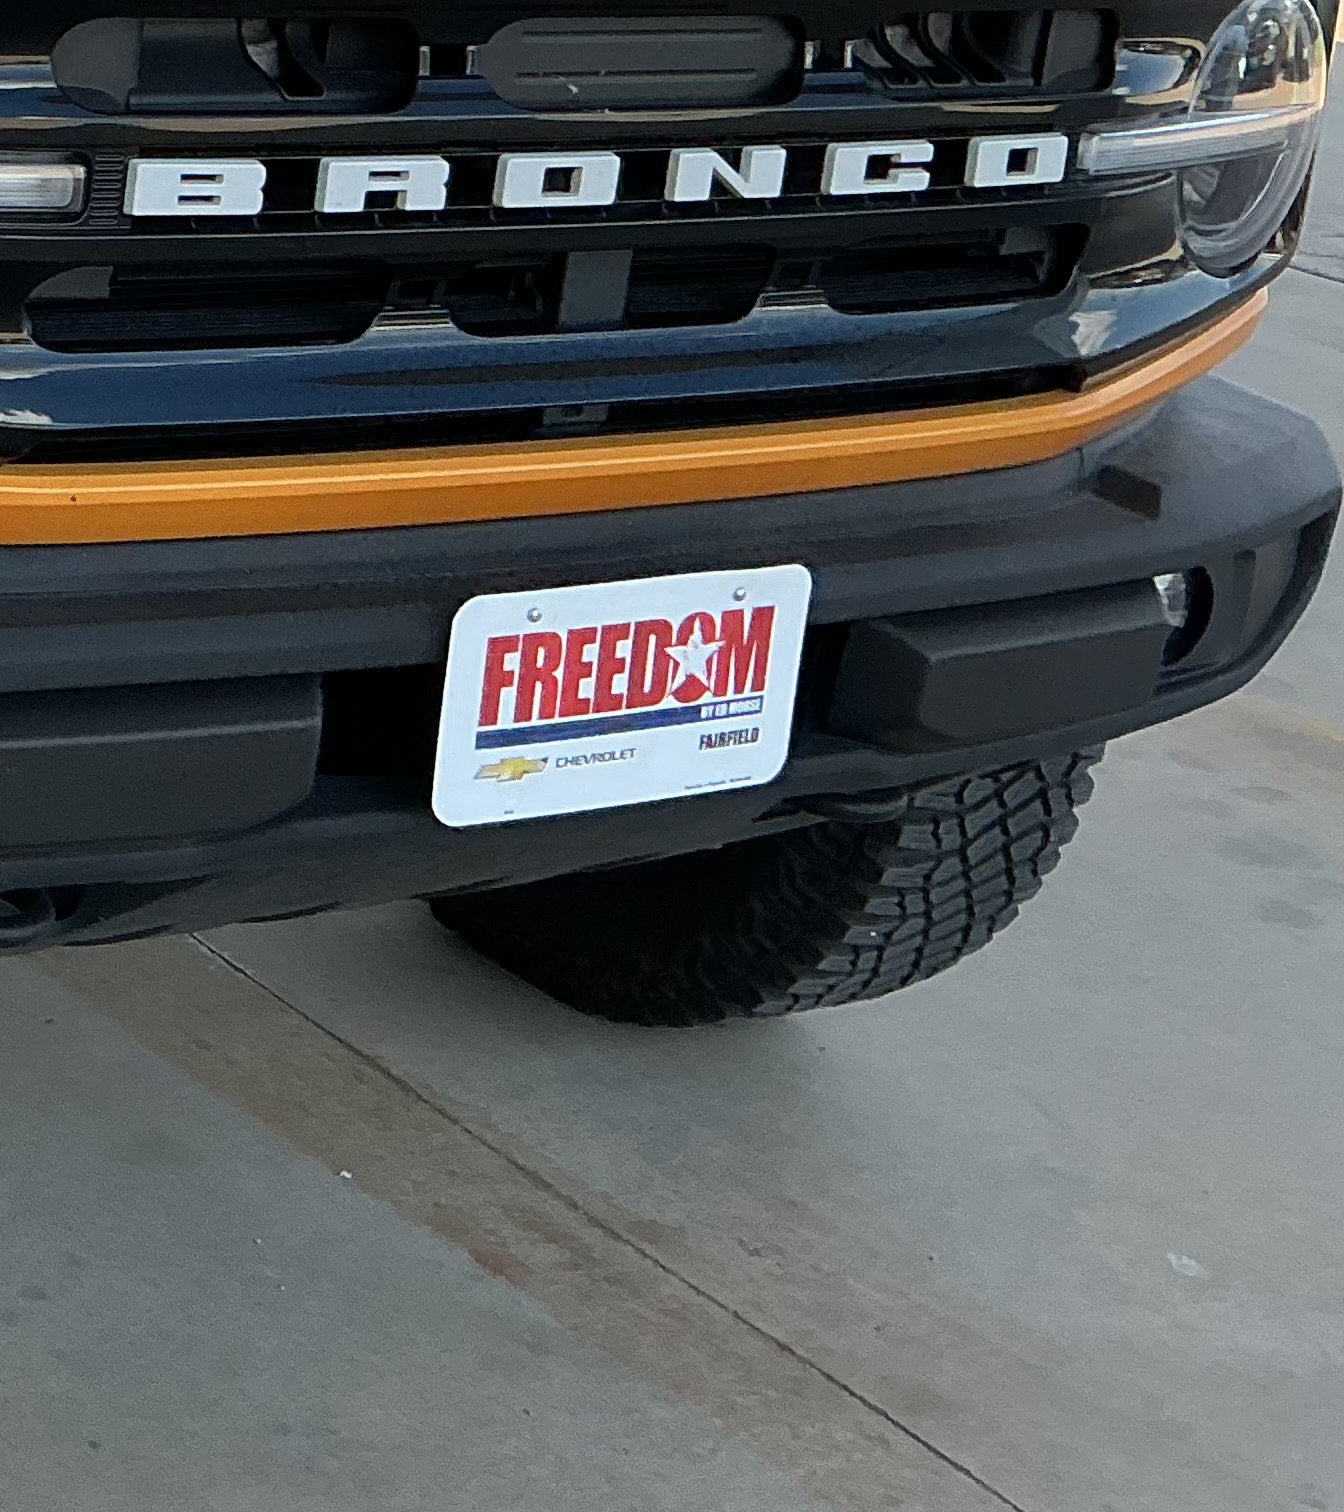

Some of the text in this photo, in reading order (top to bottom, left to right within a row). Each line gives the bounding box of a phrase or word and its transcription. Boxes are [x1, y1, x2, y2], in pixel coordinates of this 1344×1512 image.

[123, 131, 1070, 217] BRONCO
[479, 605, 776, 726] FREEDOM
[555, 748, 637, 768] CHEVROLET
[699, 727, 760, 750] FAIRFIELD
